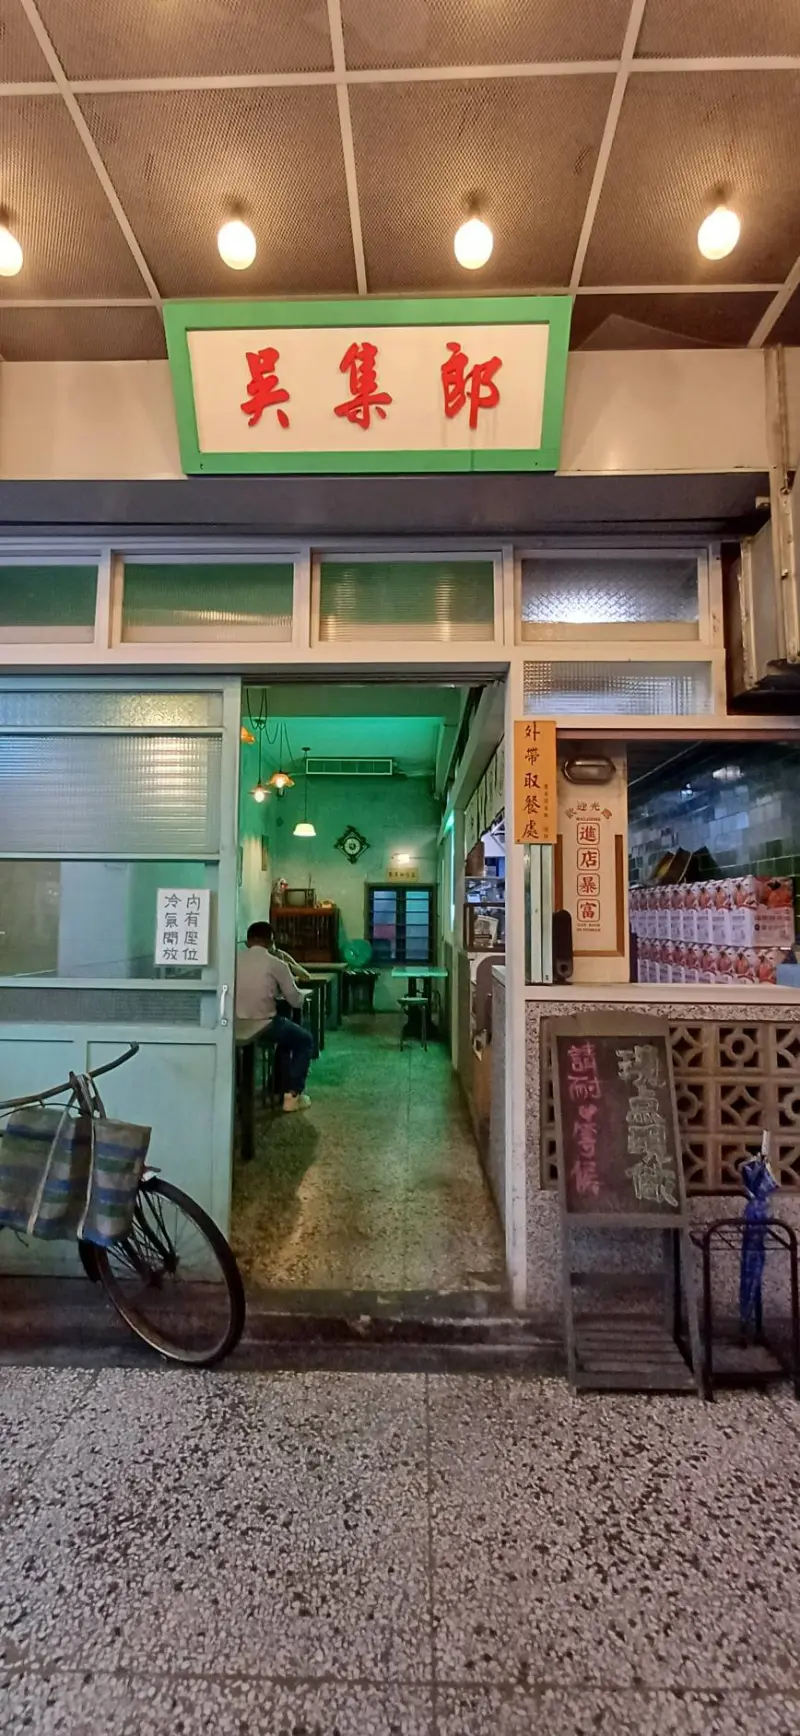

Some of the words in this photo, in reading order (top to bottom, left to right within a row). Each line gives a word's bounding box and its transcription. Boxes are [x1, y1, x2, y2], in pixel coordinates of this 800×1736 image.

[240, 341, 503, 430] 吳集郎
[521, 721, 541, 840] 外帶取餐處
[579, 825, 598, 920] 進店暴富
[162, 893, 183, 961] 冷氣開放
[182, 893, 202, 962] 內有座位
